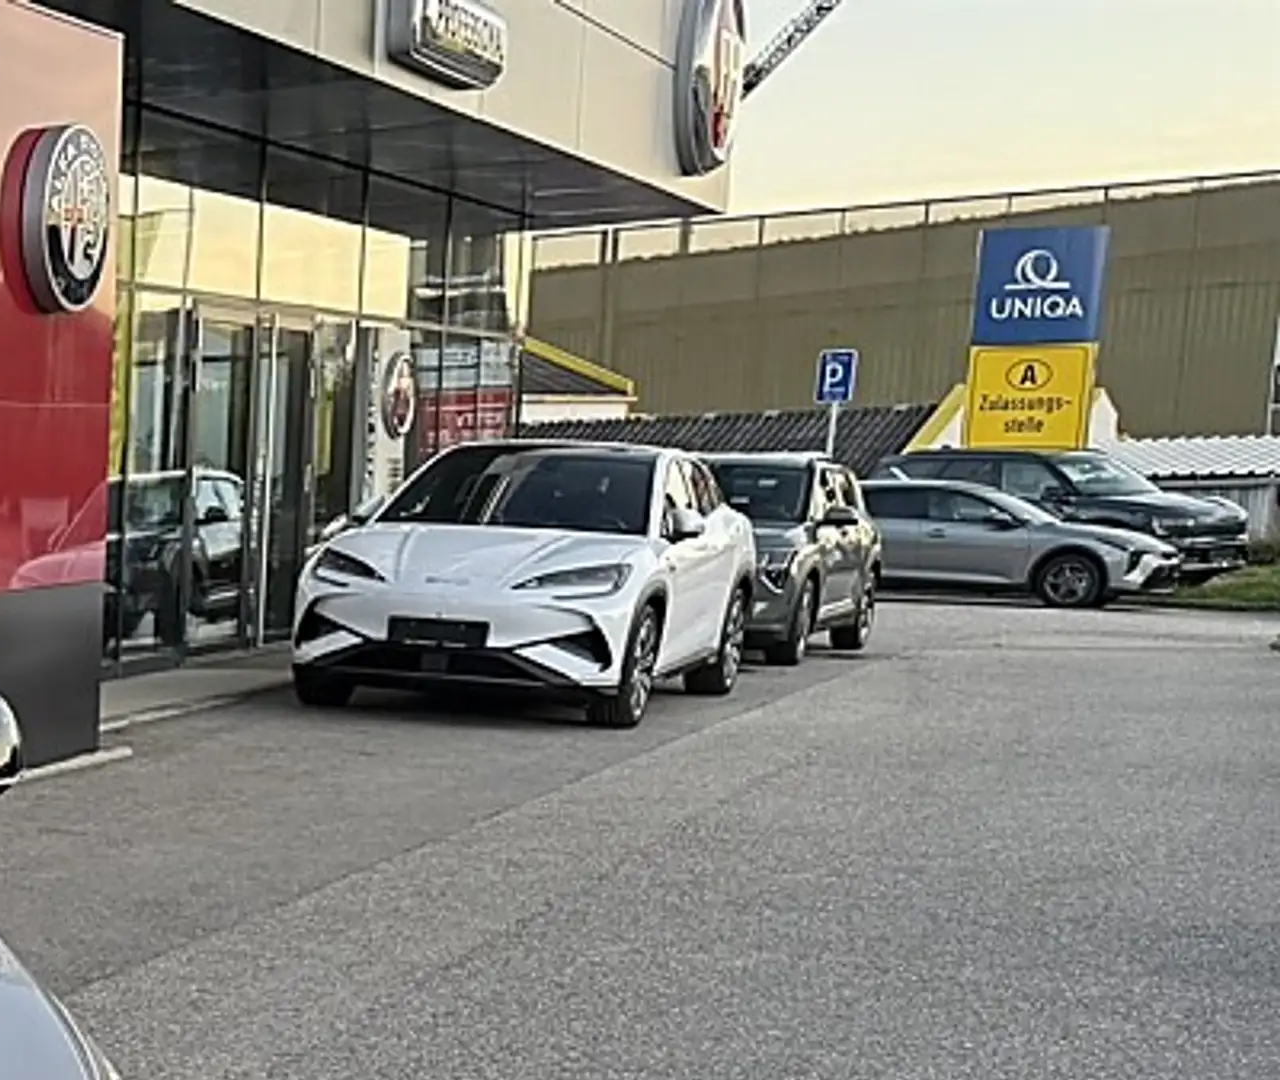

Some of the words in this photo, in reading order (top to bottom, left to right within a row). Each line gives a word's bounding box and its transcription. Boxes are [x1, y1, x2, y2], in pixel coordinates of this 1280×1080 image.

[990, 295, 1084, 319] UNIQA
[823, 361, 844, 392] P
[1019, 364, 1037, 385] A
[1004, 416, 1045, 434] stelle
